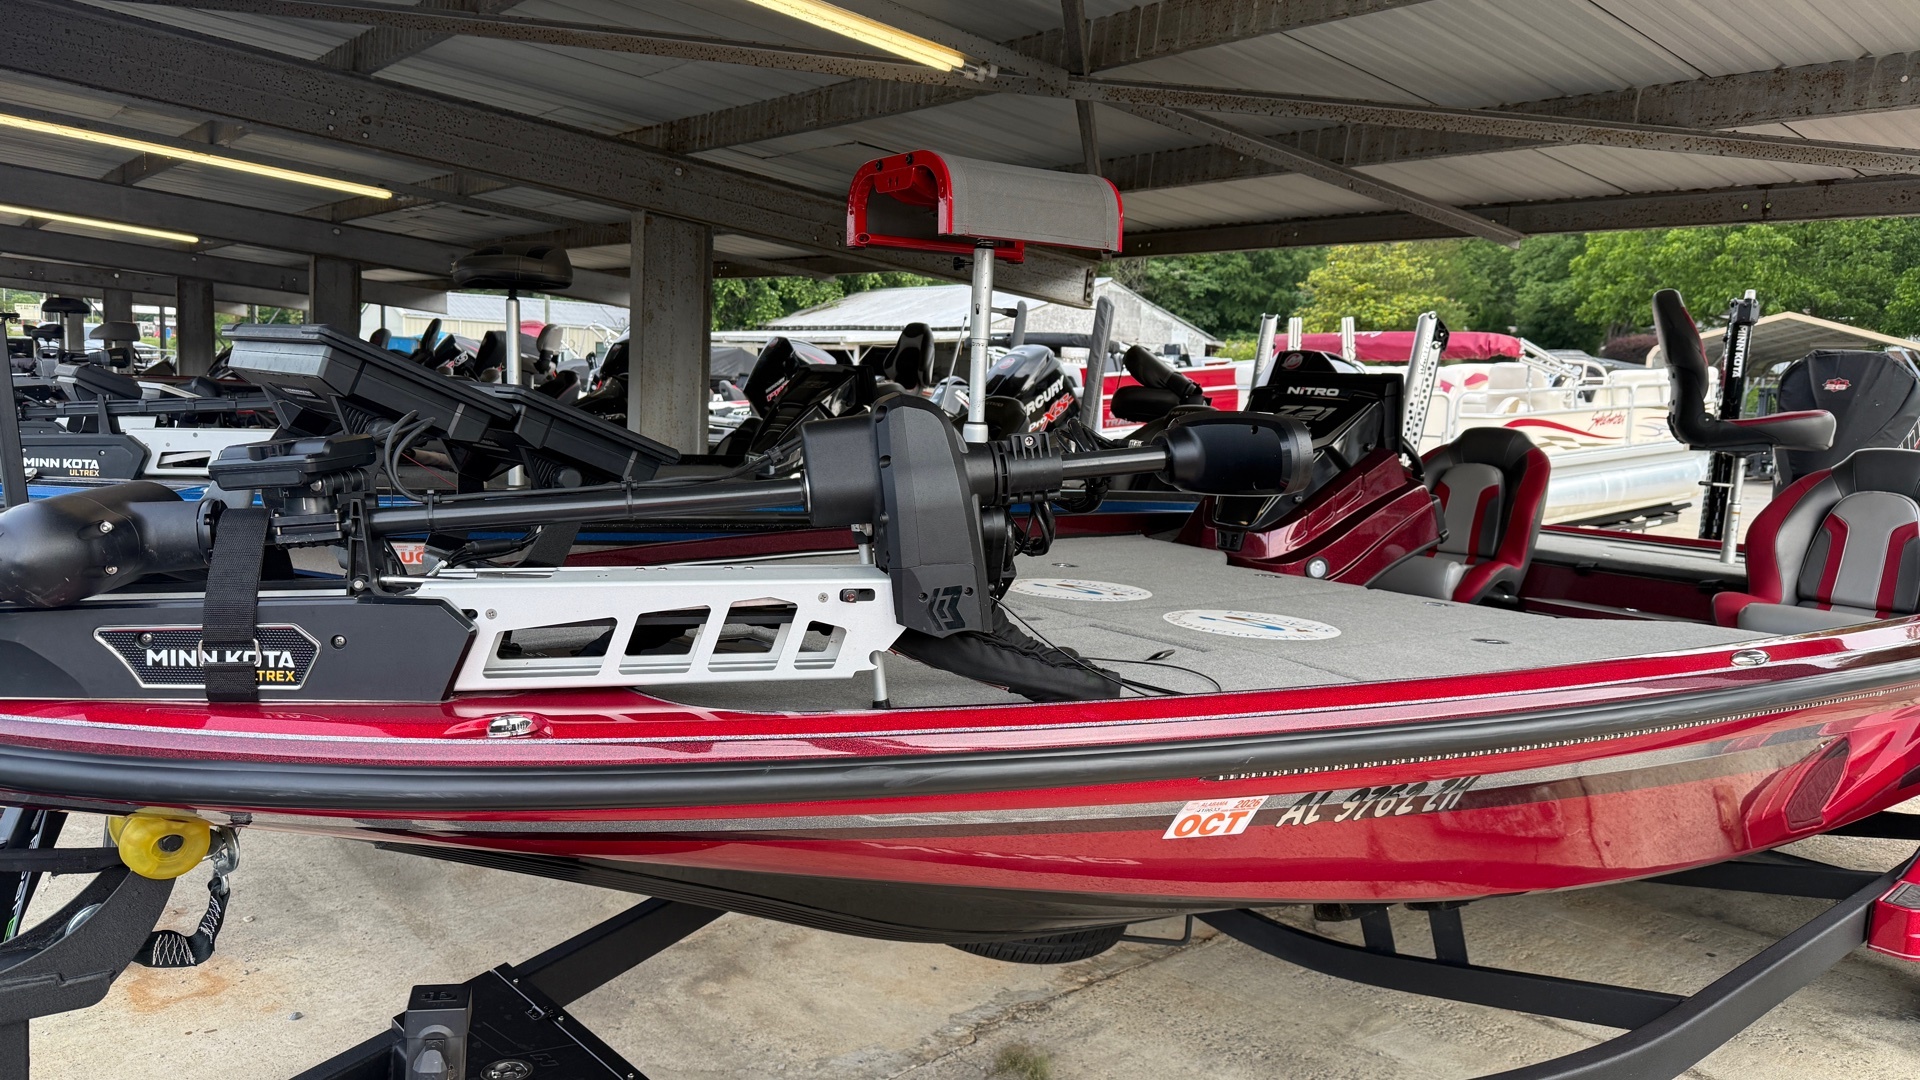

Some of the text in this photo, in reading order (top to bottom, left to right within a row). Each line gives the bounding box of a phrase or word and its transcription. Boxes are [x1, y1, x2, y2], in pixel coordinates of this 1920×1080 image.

[1731, 325, 1749, 378] MINN KOTA
[1023, 374, 1065, 417] RCURY
[1275, 404, 1338, 421] Z21
[23, 457, 100, 470] MINN KOTA
[69, 469, 100, 477] ULTREX
[146, 649, 296, 668] MINN KOTA
[255, 670, 296, 682] TREX
[1233, 798, 1264, 809] 2026
[1275, 775, 1481, 828] AL 9762 ZH
[1173, 811, 1250, 837] OCT
